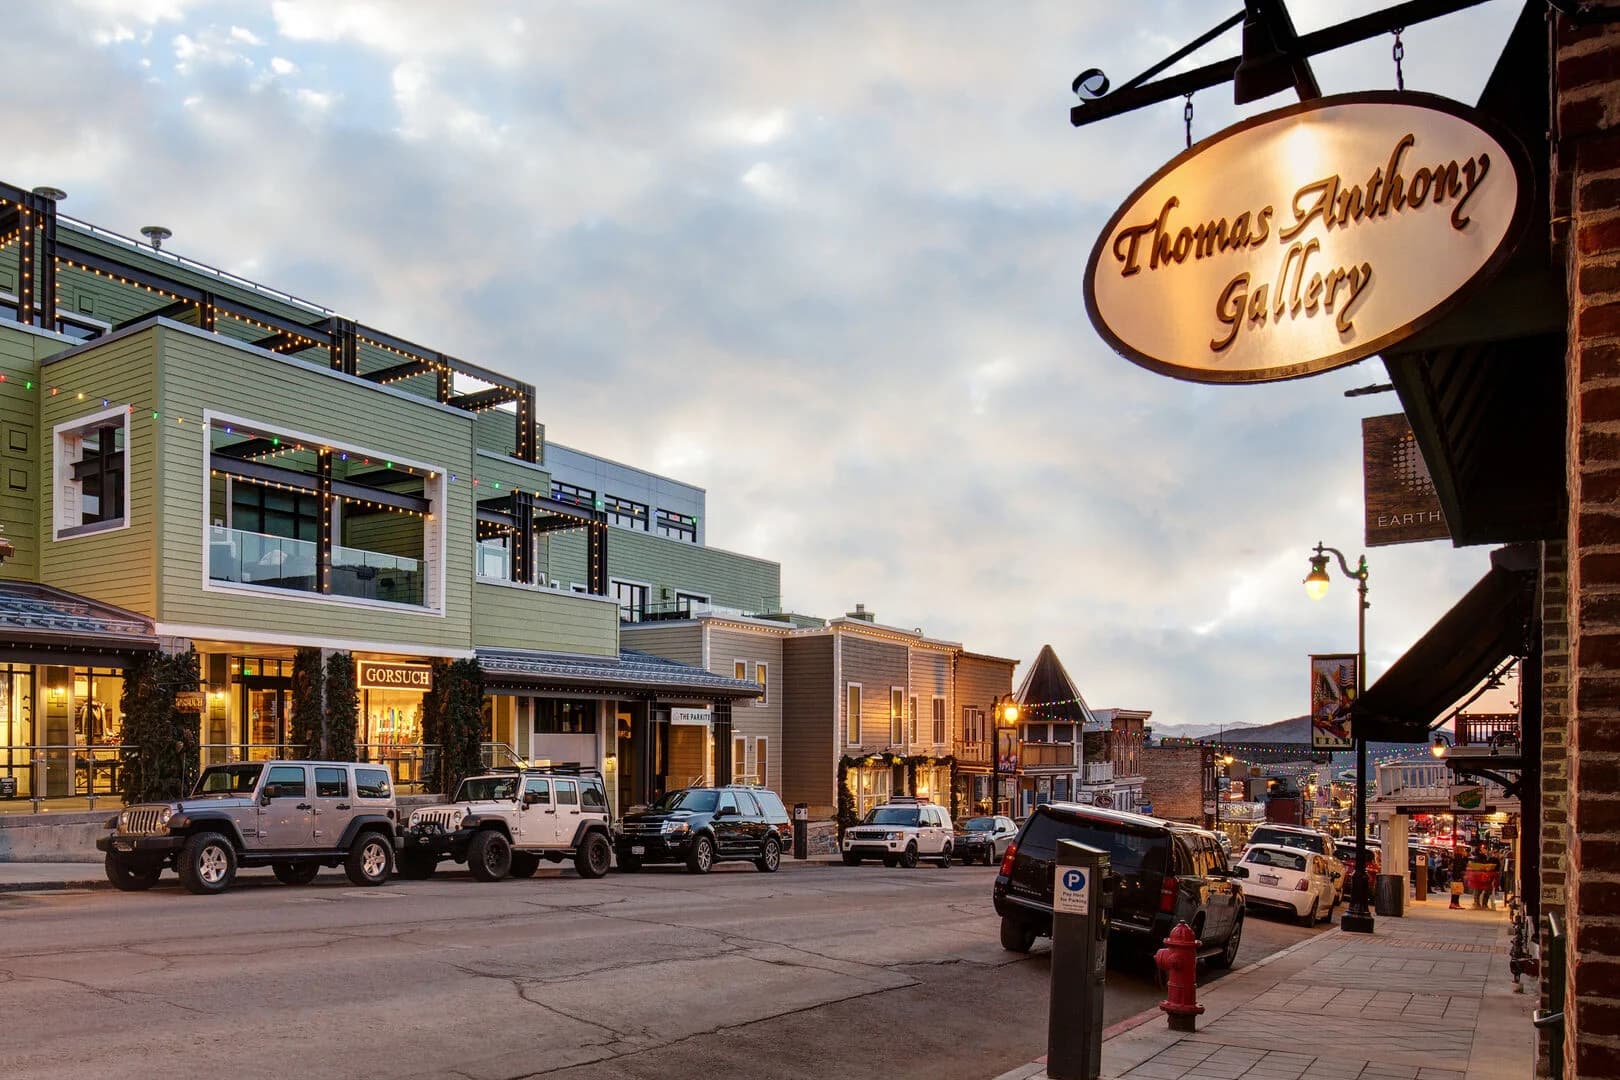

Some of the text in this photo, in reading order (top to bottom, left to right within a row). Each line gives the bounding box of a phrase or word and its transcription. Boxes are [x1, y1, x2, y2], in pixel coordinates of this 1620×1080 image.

[1112, 133, 1491, 277] Thomas Anthony
[1210, 237, 1373, 351] Gallery
[1378, 510, 1441, 527] EARTH
[366, 668, 430, 685] GORSUCH
[680, 713, 689, 721] THE
[1316, 736, 1351, 745] UTAH
[1068, 873, 1080, 888] P
